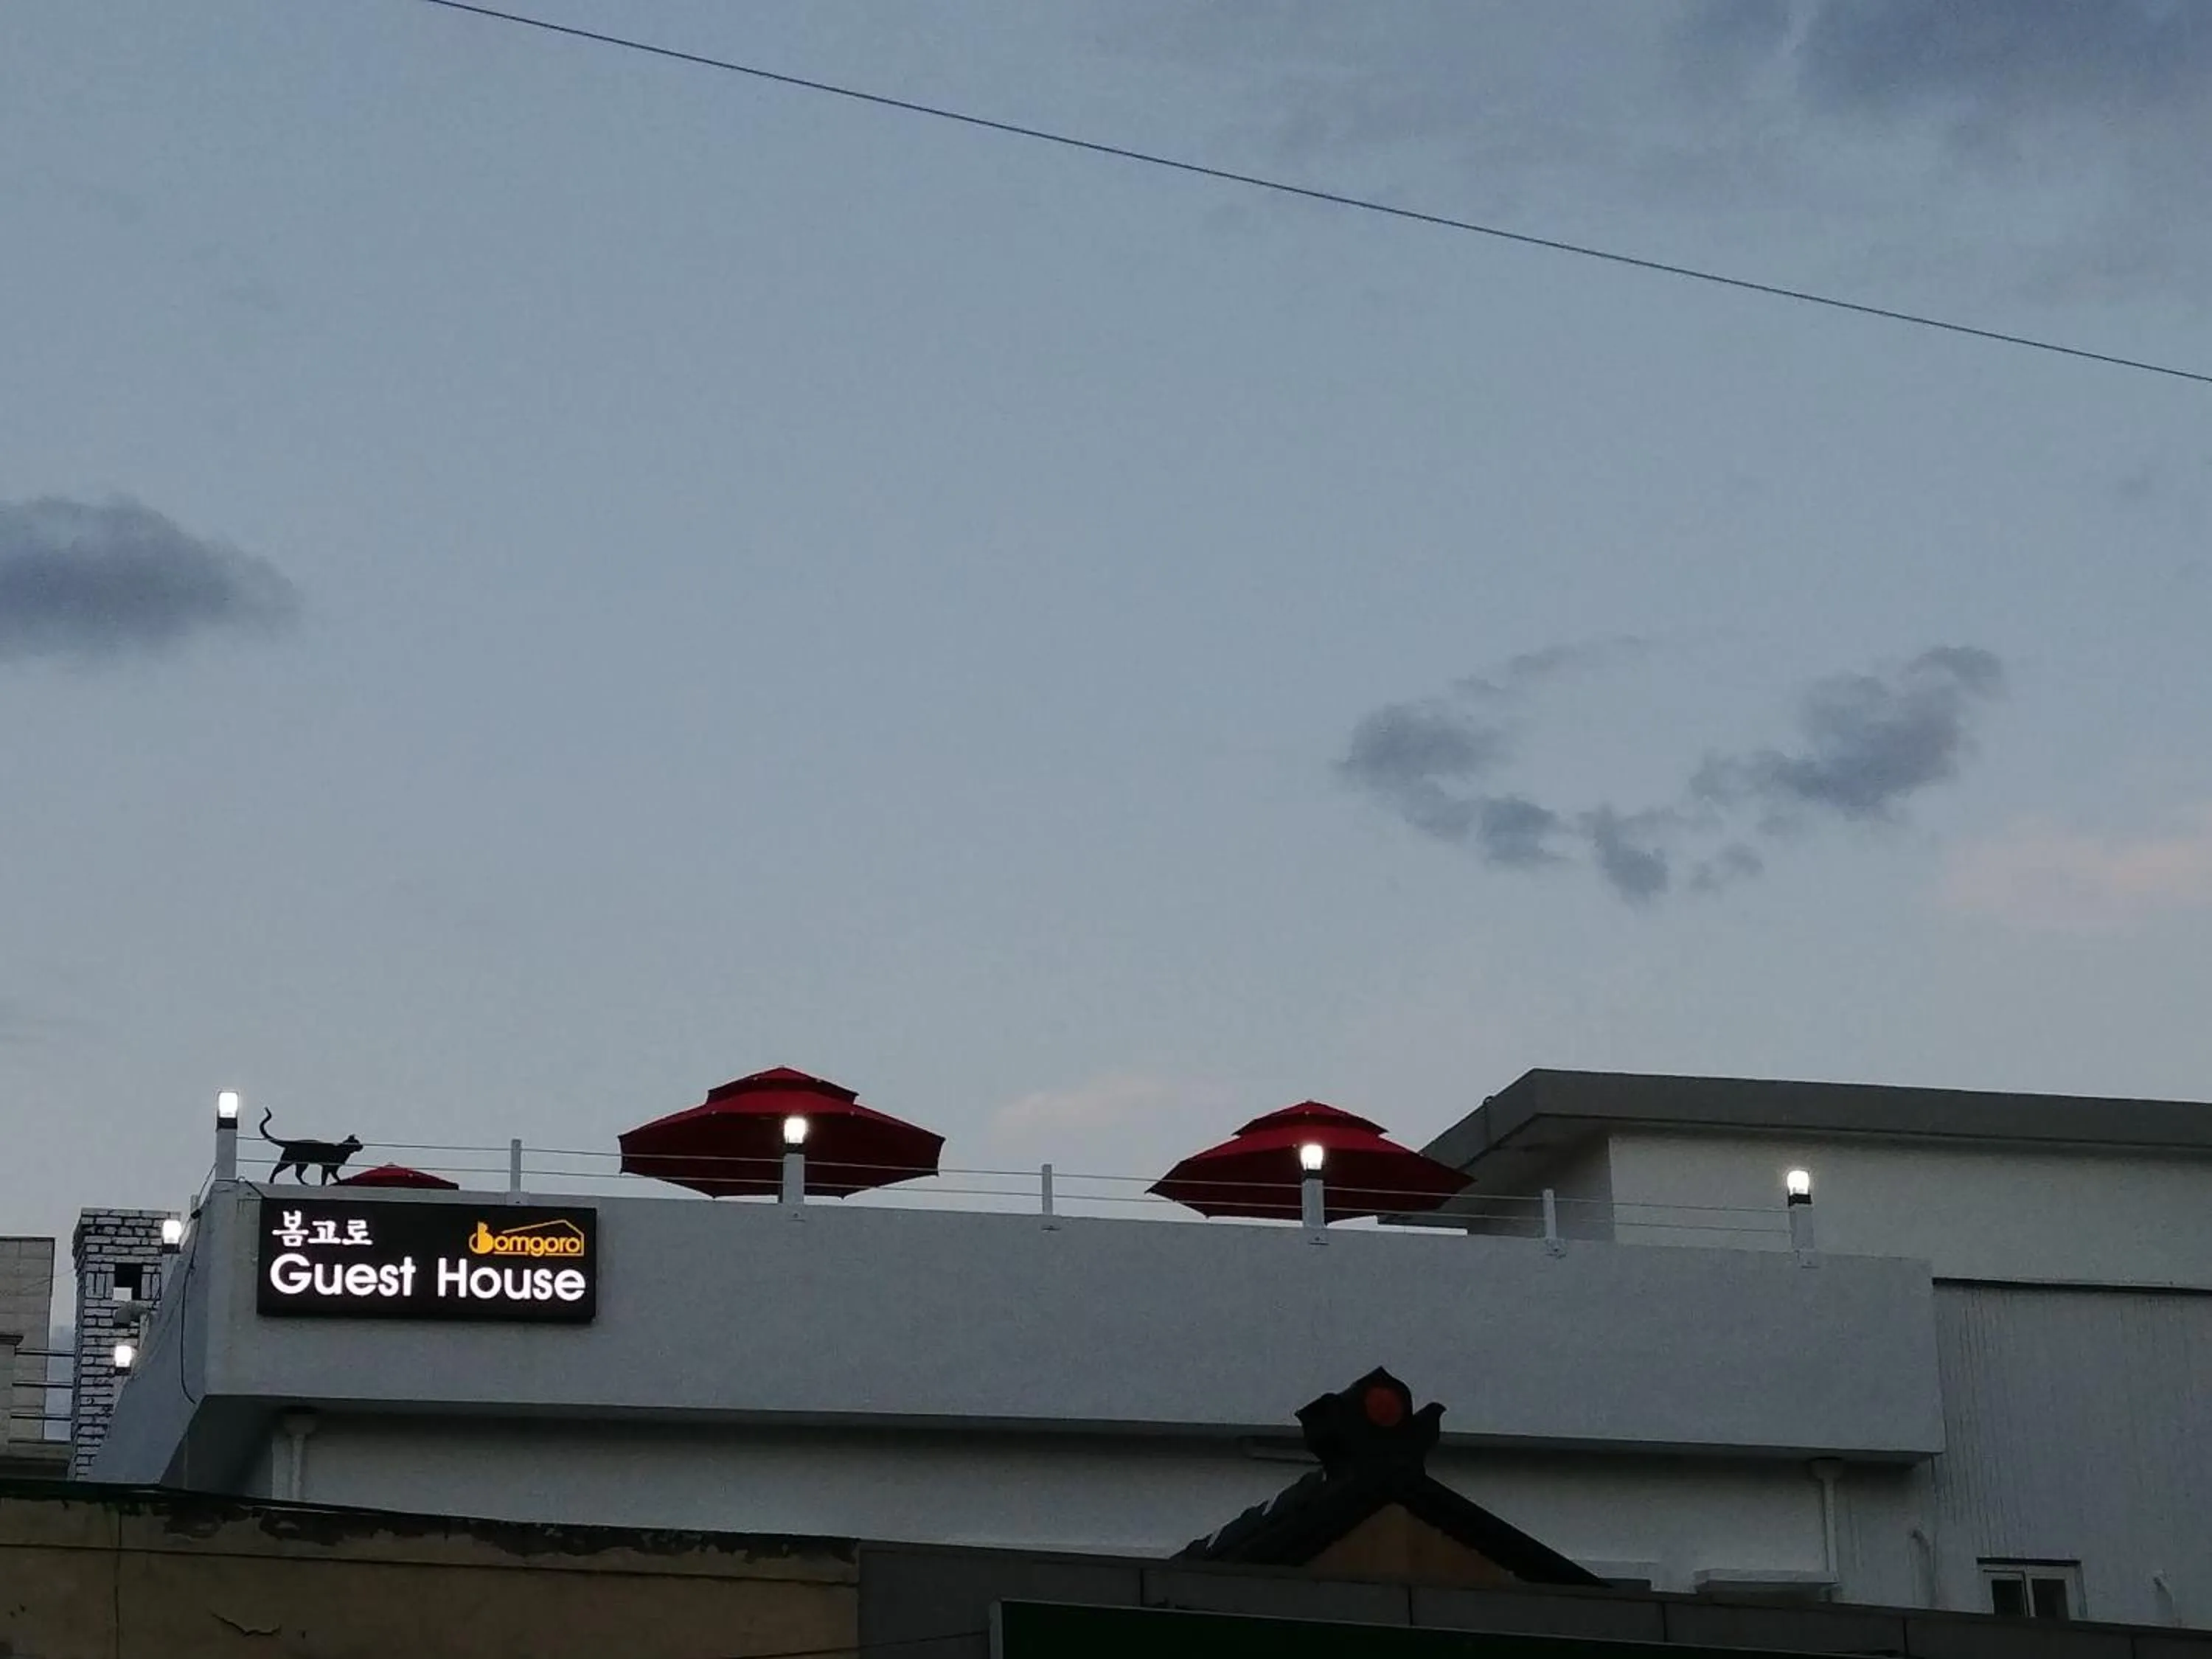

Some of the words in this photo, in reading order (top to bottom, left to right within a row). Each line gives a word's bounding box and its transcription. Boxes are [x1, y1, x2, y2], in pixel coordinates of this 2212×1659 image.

[272, 1210, 372, 1247] 봄고로
[270, 1253, 417, 1297] Guest
[437, 1258, 586, 1301] House
